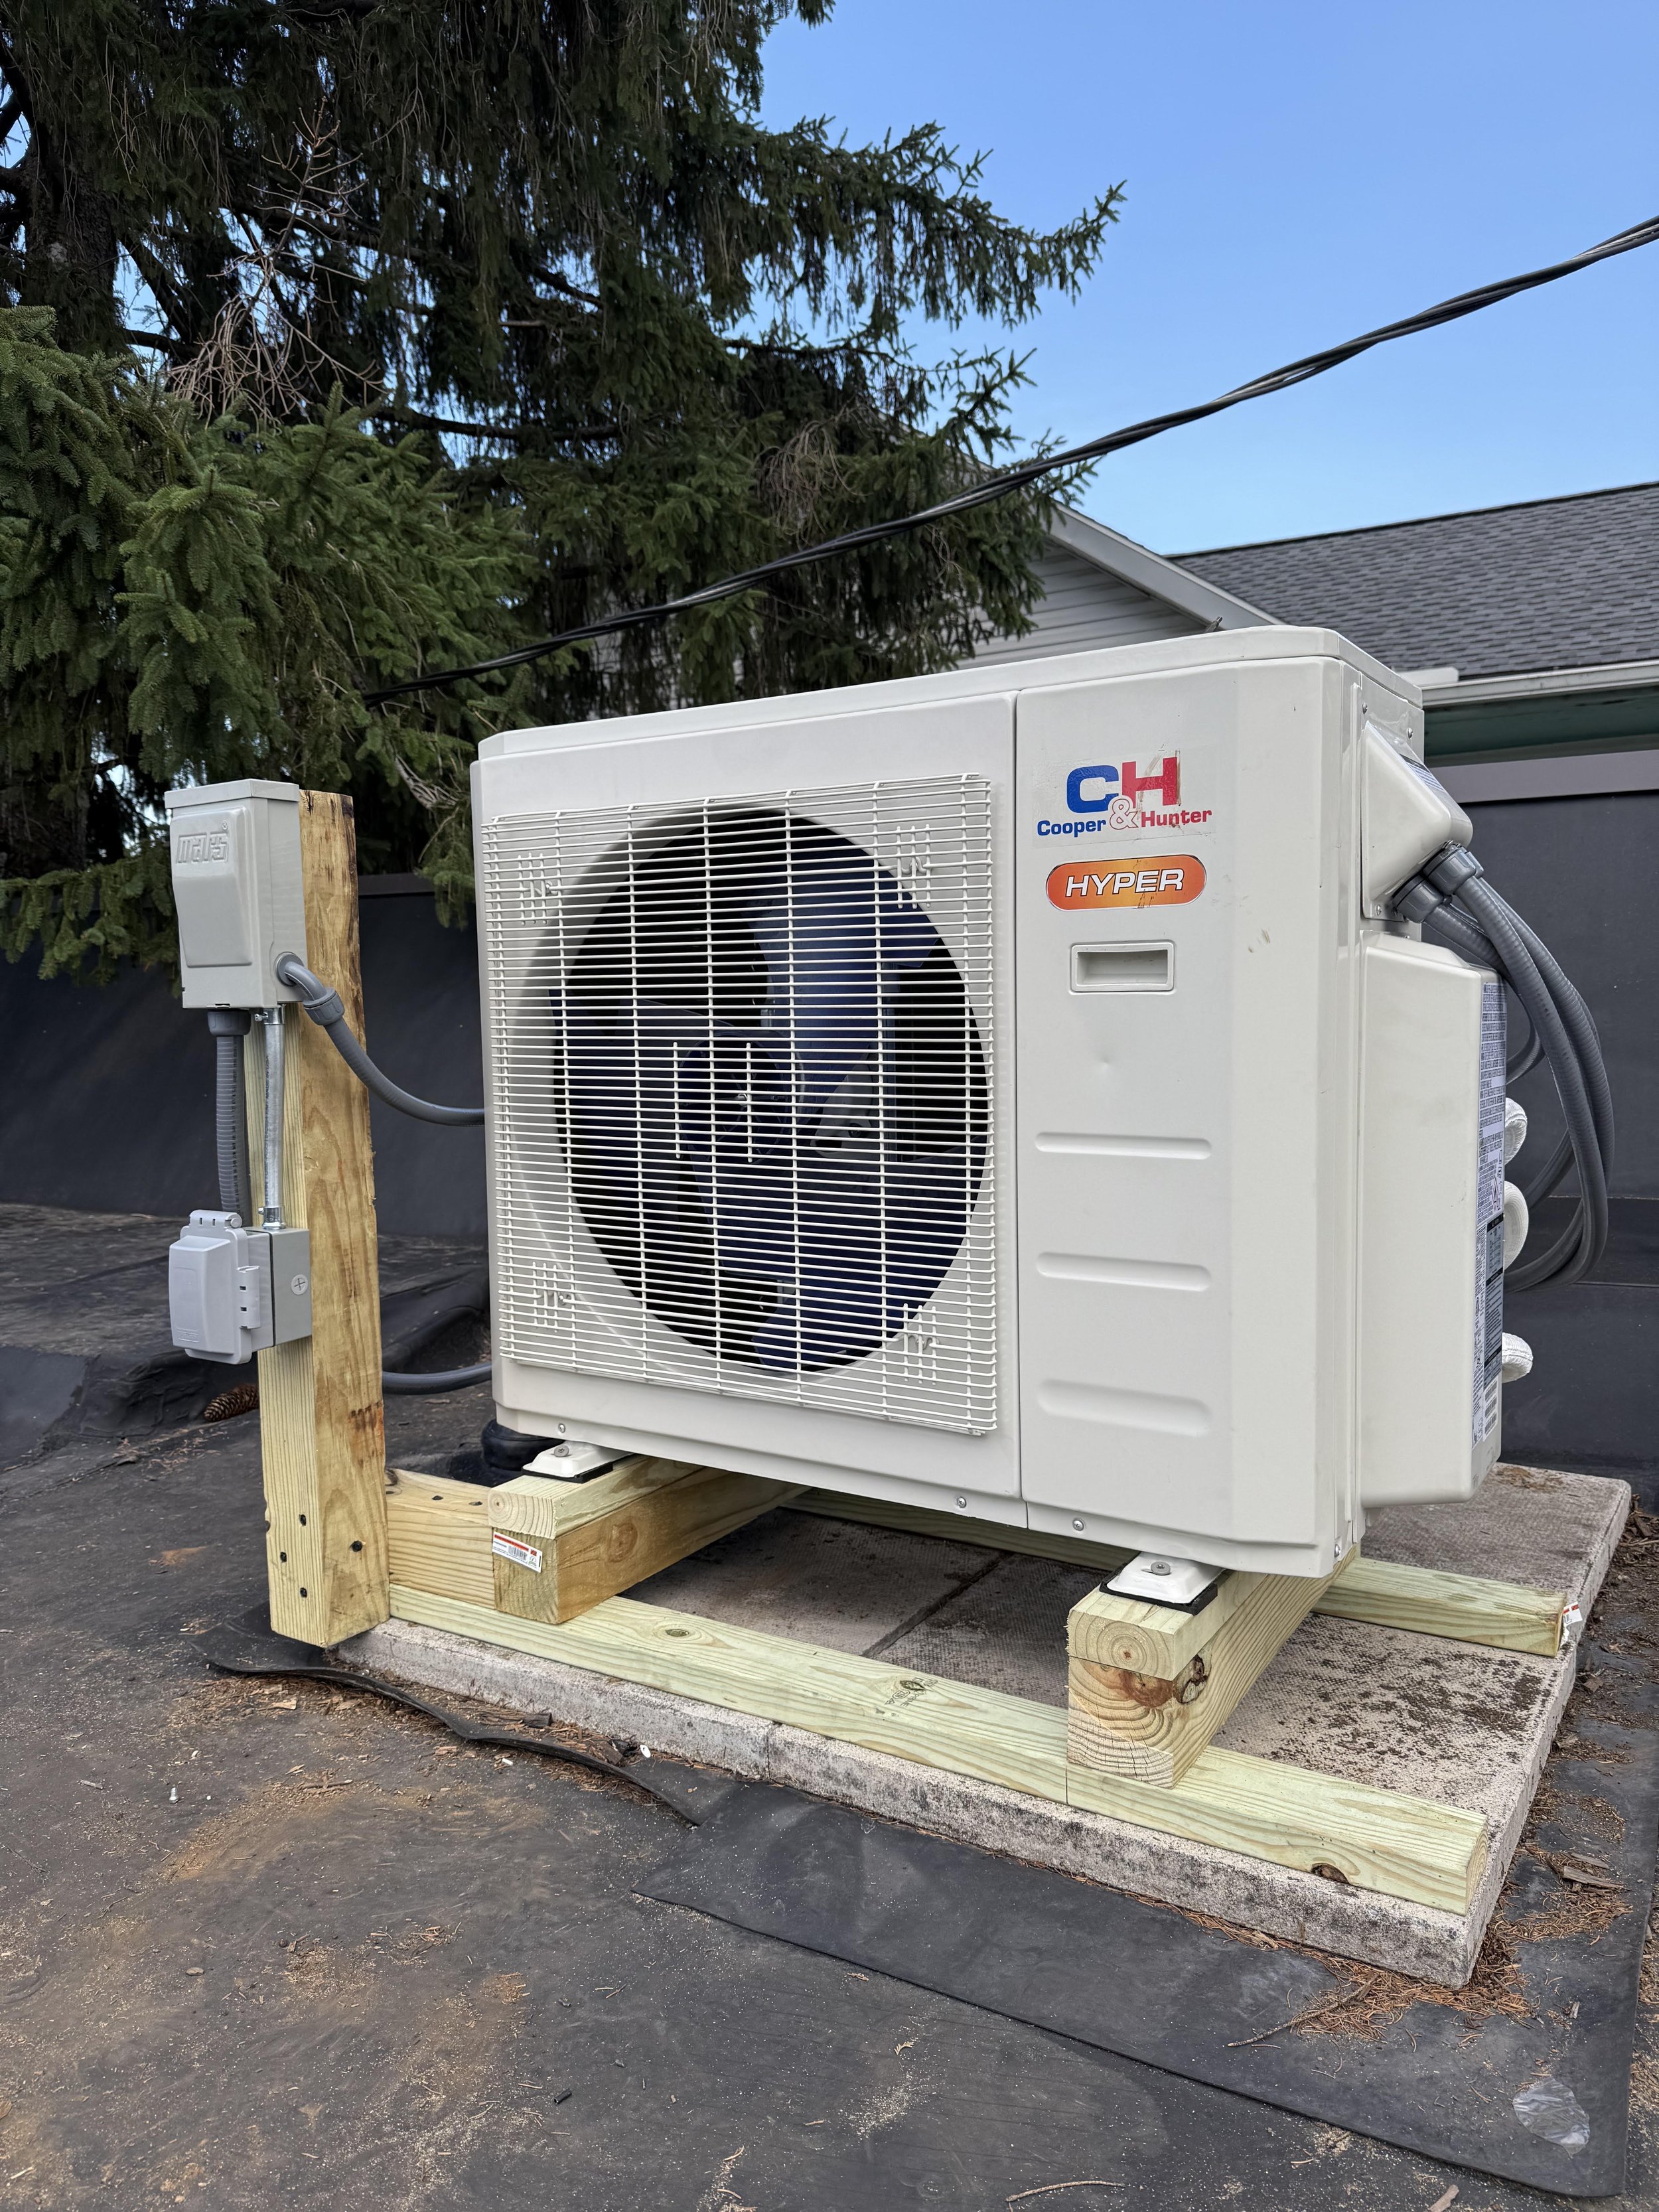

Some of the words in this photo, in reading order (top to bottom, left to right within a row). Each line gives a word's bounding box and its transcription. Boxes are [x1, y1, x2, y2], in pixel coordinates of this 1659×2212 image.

[1037, 819, 1107, 838] Cooper
[1110, 798, 1139, 830] &
[1141, 808, 1212, 828] Hunter
[1065, 868, 1185, 898] HYPER
